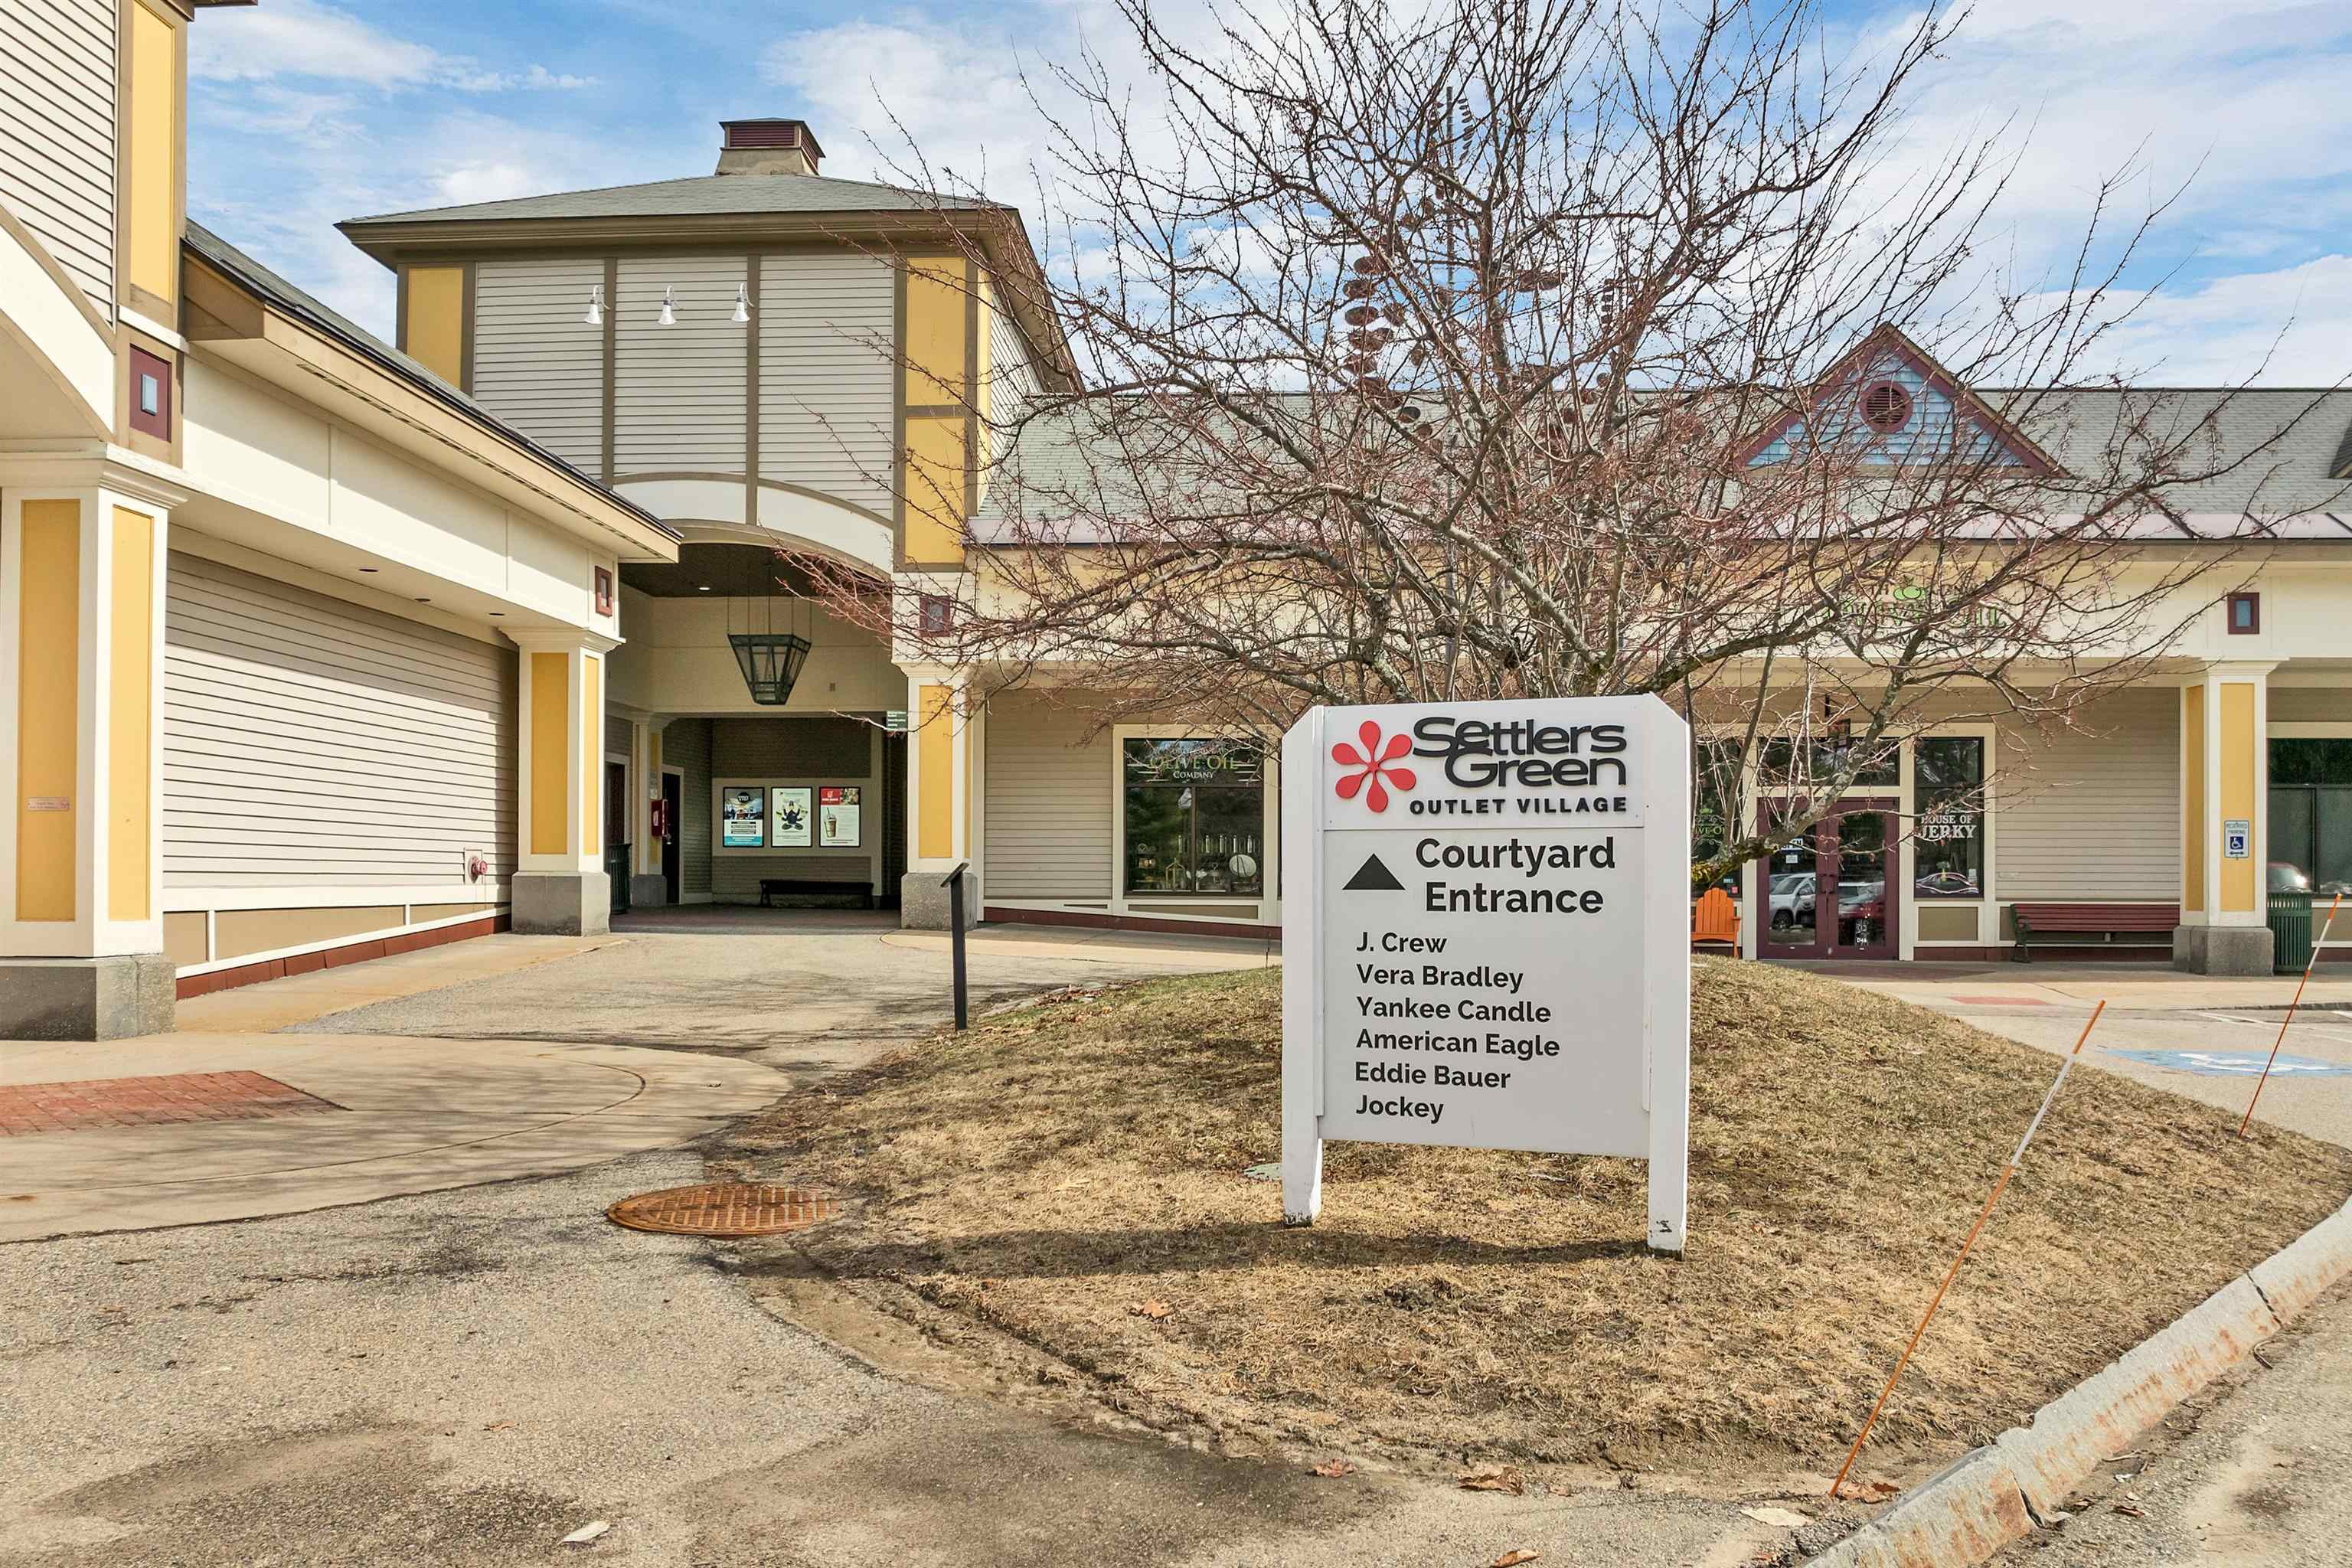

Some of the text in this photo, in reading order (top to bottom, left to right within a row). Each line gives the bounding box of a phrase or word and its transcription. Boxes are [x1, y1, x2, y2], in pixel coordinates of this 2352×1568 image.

[1412, 717, 1628, 756] Settlers
[1445, 746, 1628, 788] Green
[1410, 796, 1628, 815] OUTLET VILLAGE
[1921, 815, 1974, 825] HOUSE OF
[1922, 825, 1977, 839] JERKY
[1415, 836, 1616, 878] Courtyard
[1425, 881, 1605, 914] Entrance
[1355, 931, 1449, 954] J. Crew
[1356, 963, 1524, 995] Vera Bradley
[1356, 996, 1552, 1024] Yankee Candle
[1355, 1027, 1561, 1062] American Eagle
[1354, 1061, 1512, 1089] Eddie Bauer
[1354, 1094, 1445, 1125] Jockey
